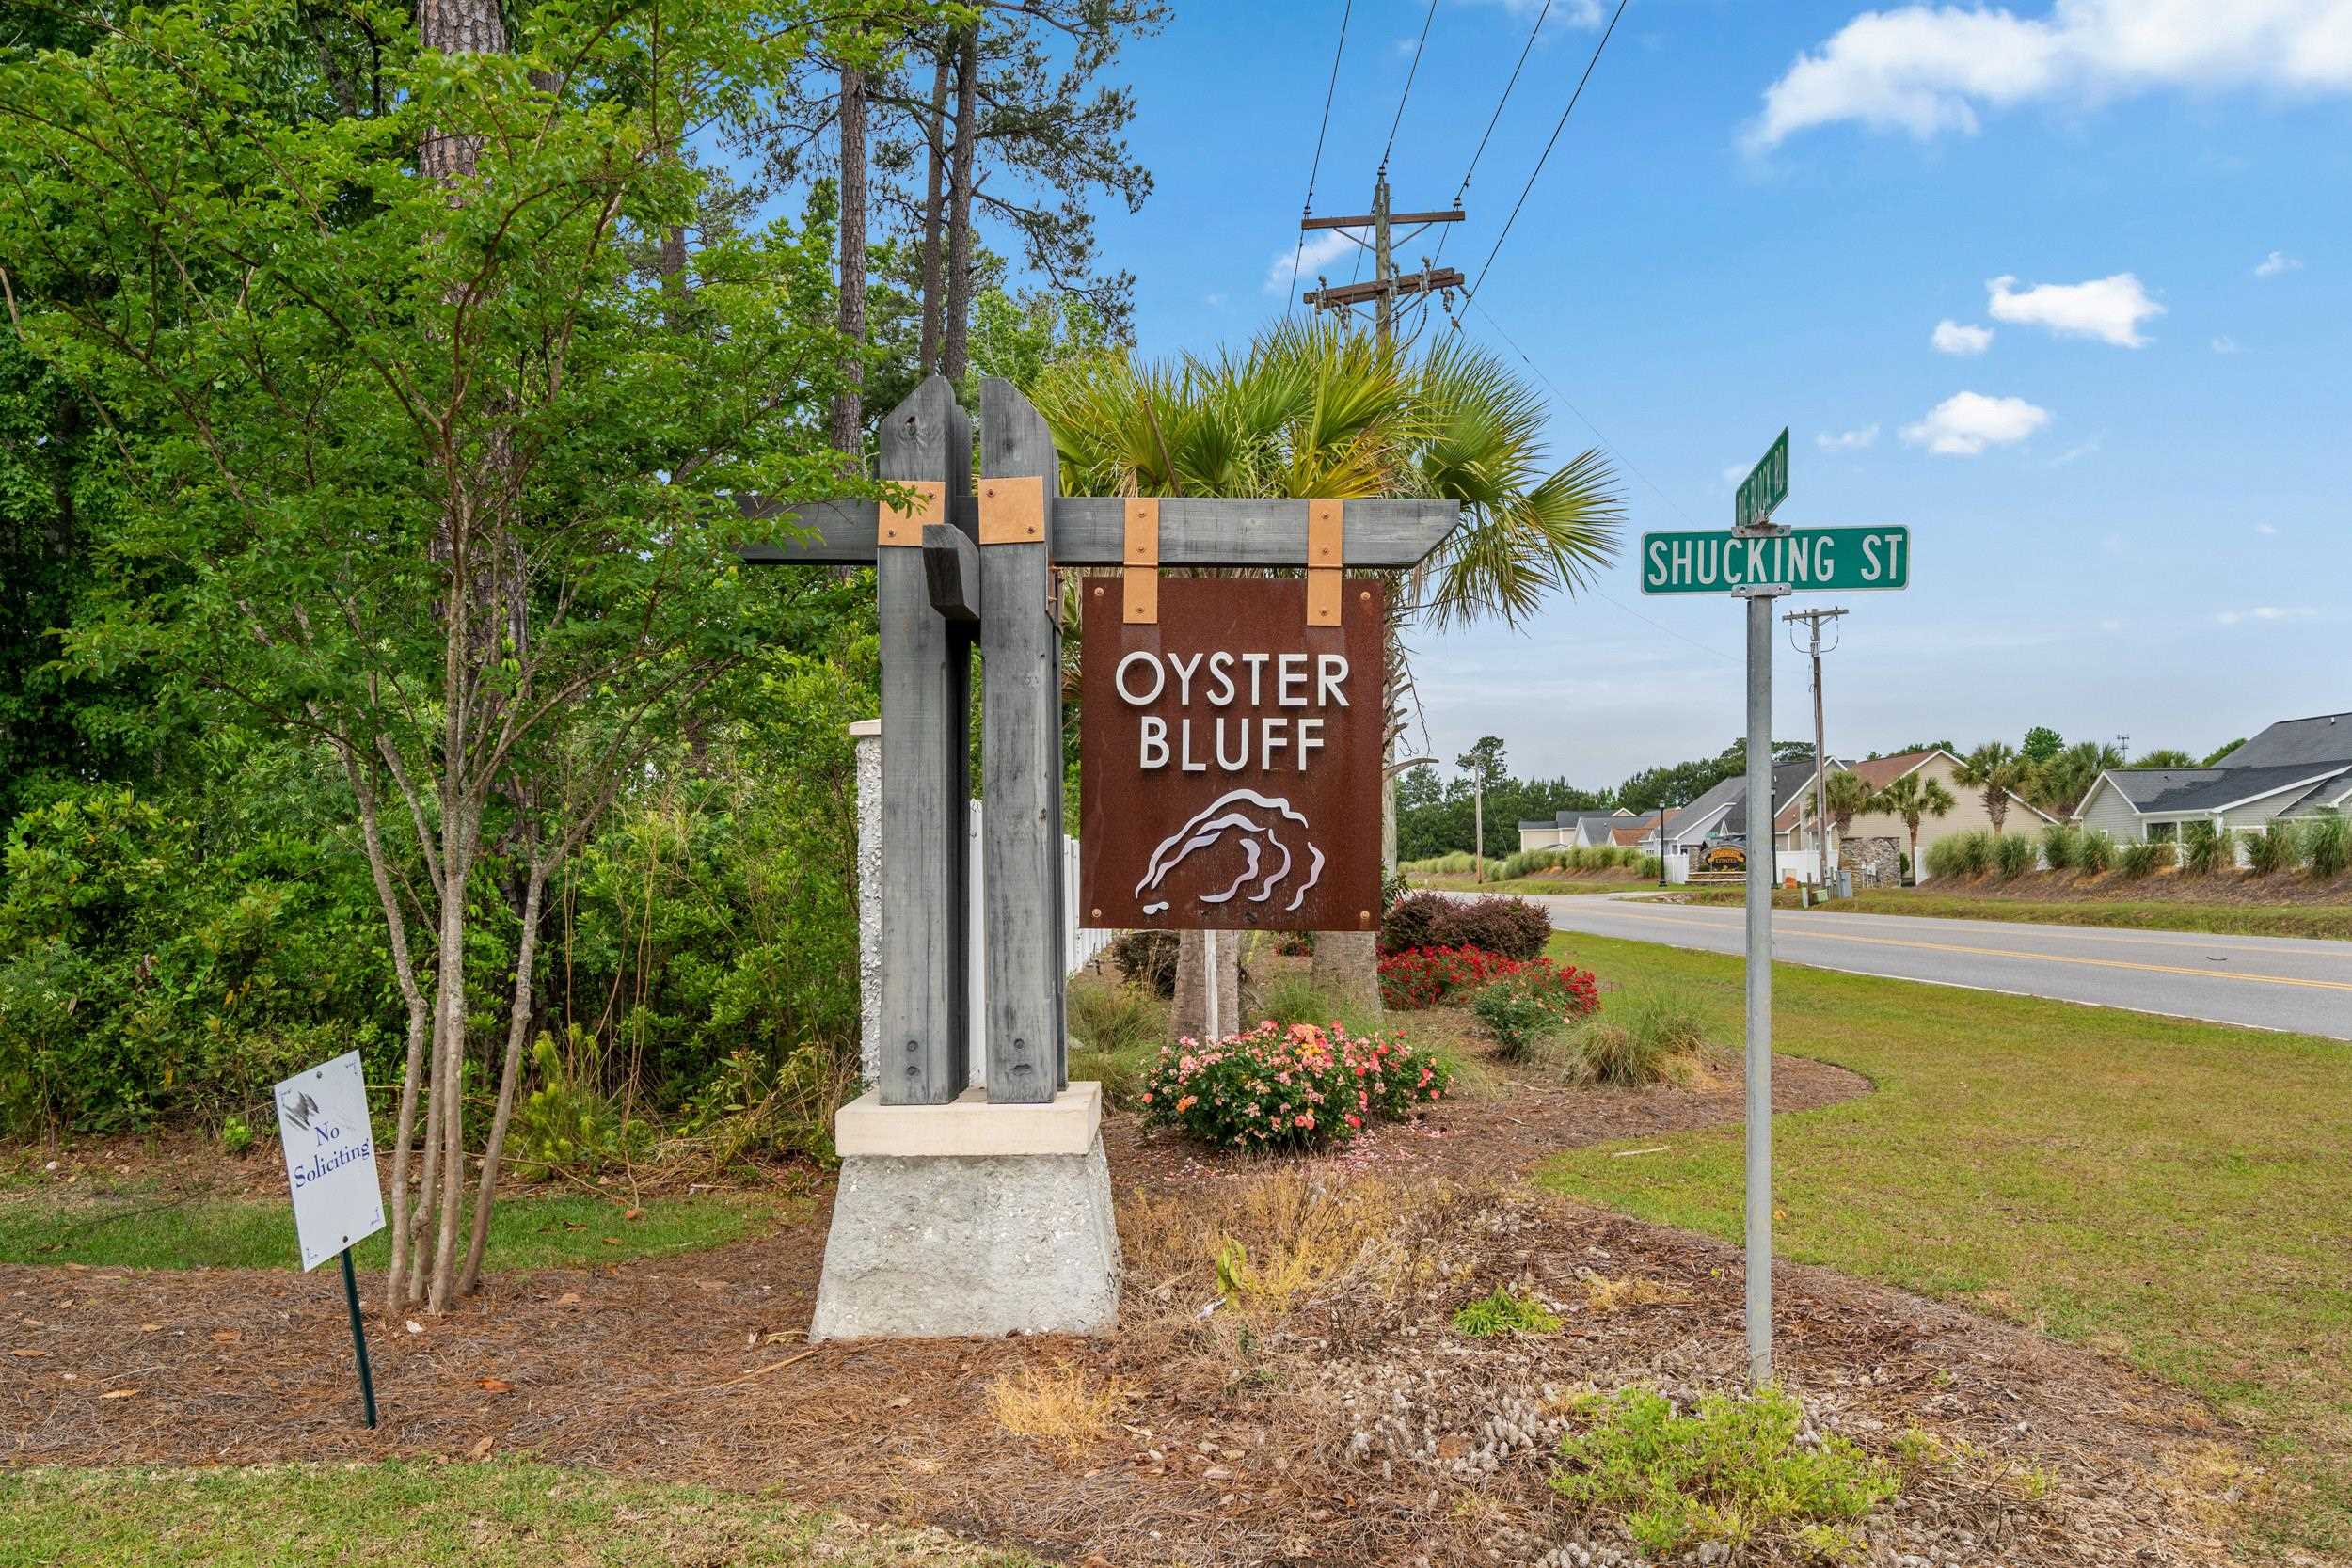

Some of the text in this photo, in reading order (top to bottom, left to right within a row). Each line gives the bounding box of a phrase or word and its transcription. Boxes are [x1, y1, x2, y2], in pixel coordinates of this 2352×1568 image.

[1775, 444, 1784, 497] RD
[1648, 534, 1903, 586] SHUCKING ST
[1115, 651, 1350, 706] OYSTER
[1140, 716, 1324, 771] BLUFF
[314, 1121, 340, 1147] No
[294, 1137, 370, 1188] Soliciting
